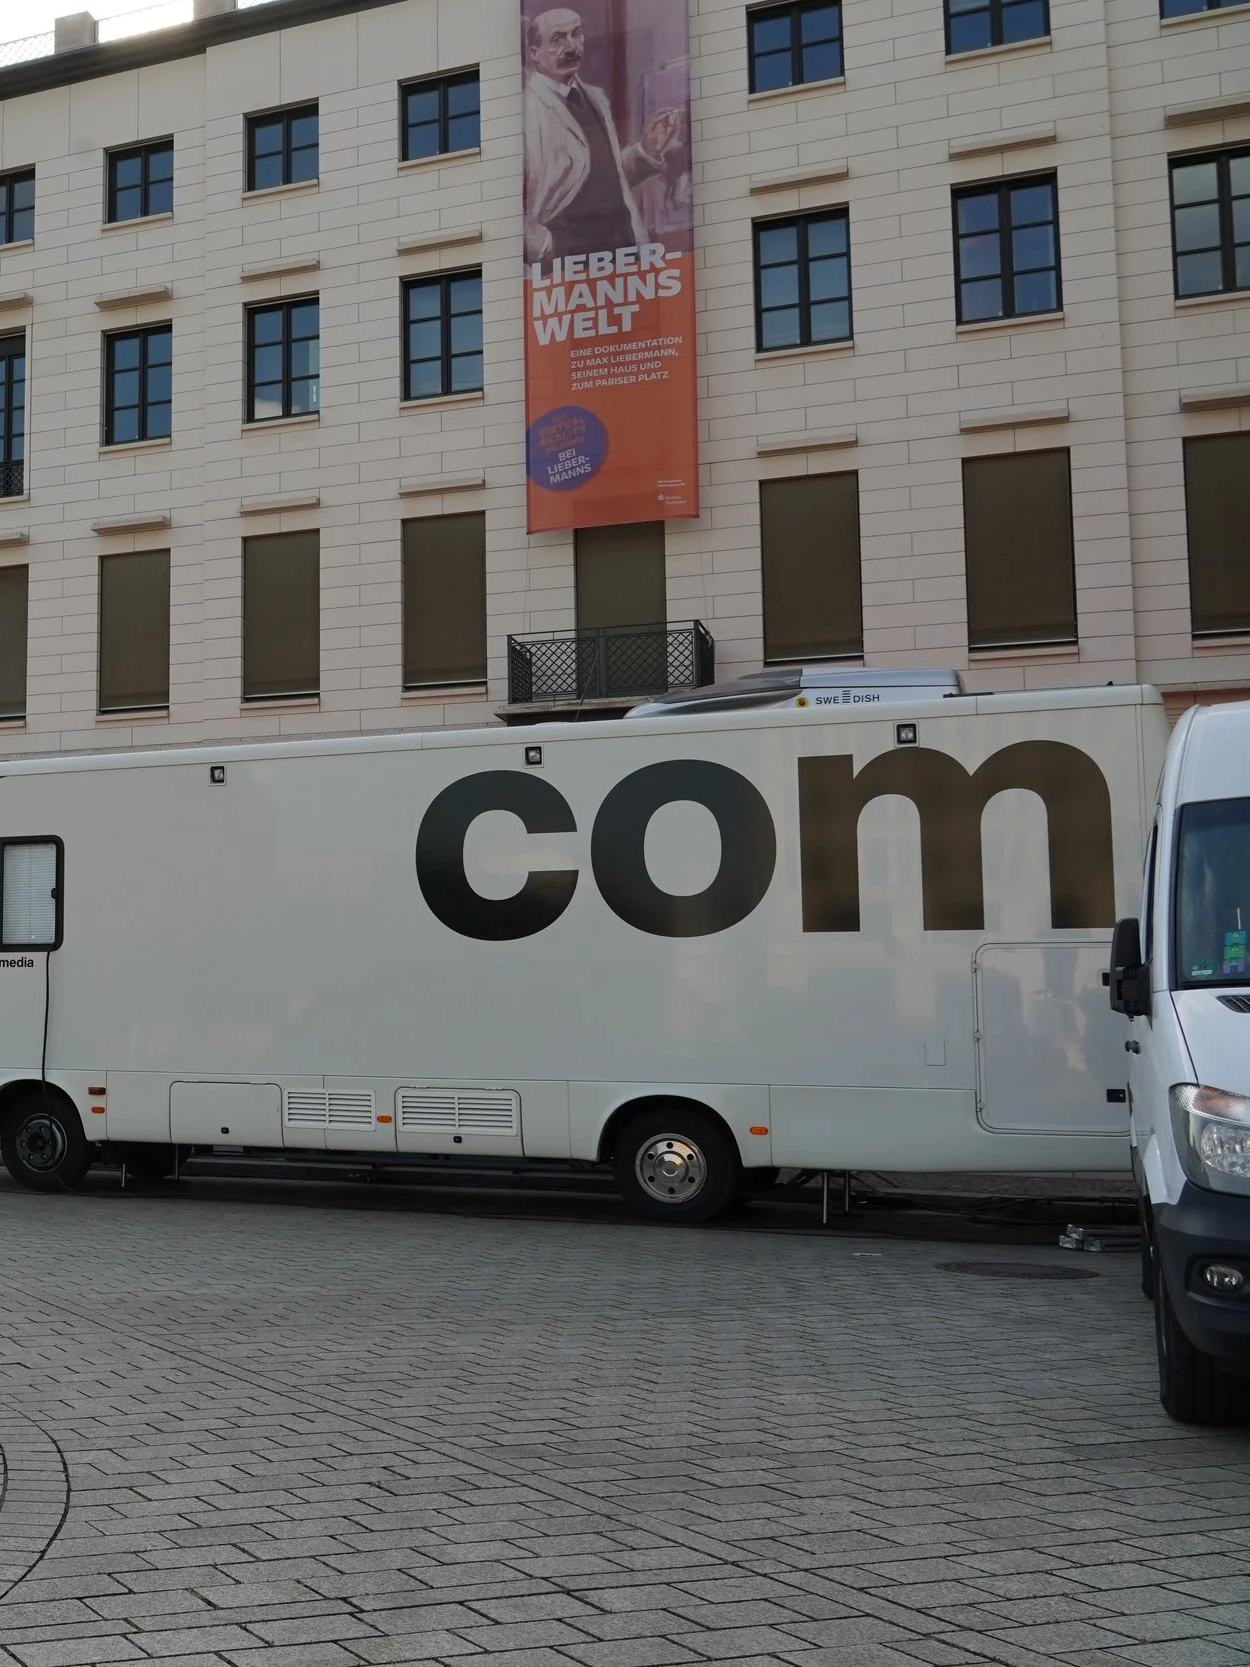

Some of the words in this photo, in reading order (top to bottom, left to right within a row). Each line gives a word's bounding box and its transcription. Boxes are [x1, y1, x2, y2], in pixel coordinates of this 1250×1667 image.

[531, 243, 682, 289] LIEBER-
[532, 268, 682, 318] MANNS
[533, 304, 640, 346] WELT
[570, 348, 592, 358] EINE
[594, 336, 683, 355] DOKUMENTATION
[570, 360, 584, 369] ZU
[586, 357, 609, 367] MAX
[611, 348, 679, 363] LIEBERMANN,
[571, 368, 608, 380] SEINEM
[611, 364, 638, 374] HAUS
[640, 361, 662, 370] UND
[571, 381, 594, 391] ZUM
[595, 376, 636, 387] PARISER
[638, 371, 669, 382] PLATZ
[547, 455, 590, 475] LIEBER-
[558, 448, 576, 461] BEI
[549, 463, 592, 484] MANNS
[416, 740, 1116, 942] com
